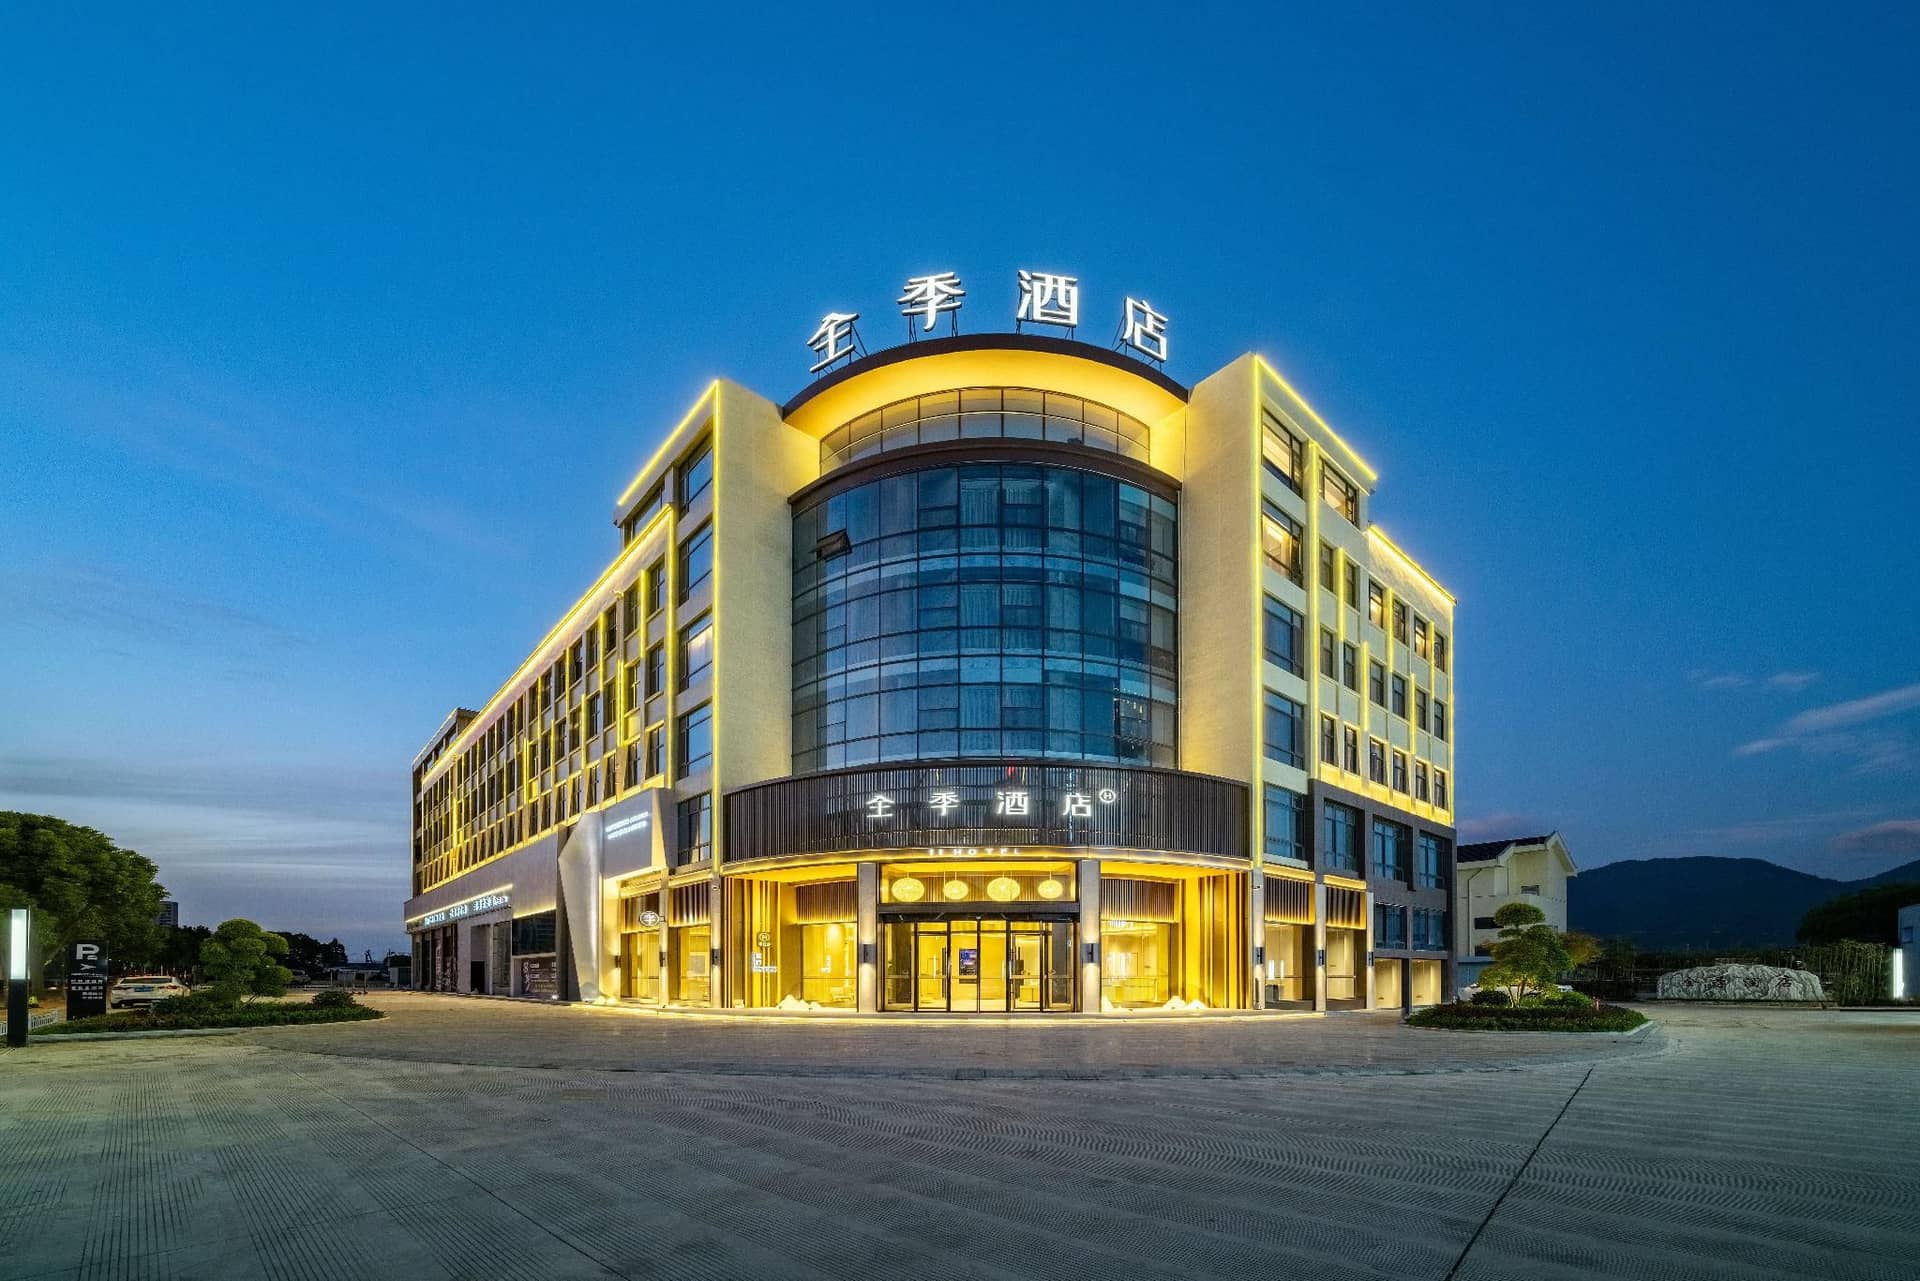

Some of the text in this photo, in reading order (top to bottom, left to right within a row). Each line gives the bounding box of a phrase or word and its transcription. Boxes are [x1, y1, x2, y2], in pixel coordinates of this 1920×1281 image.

[806, 270, 1168, 373] 全季酒店
[866, 789, 1092, 817] 全季酒店
